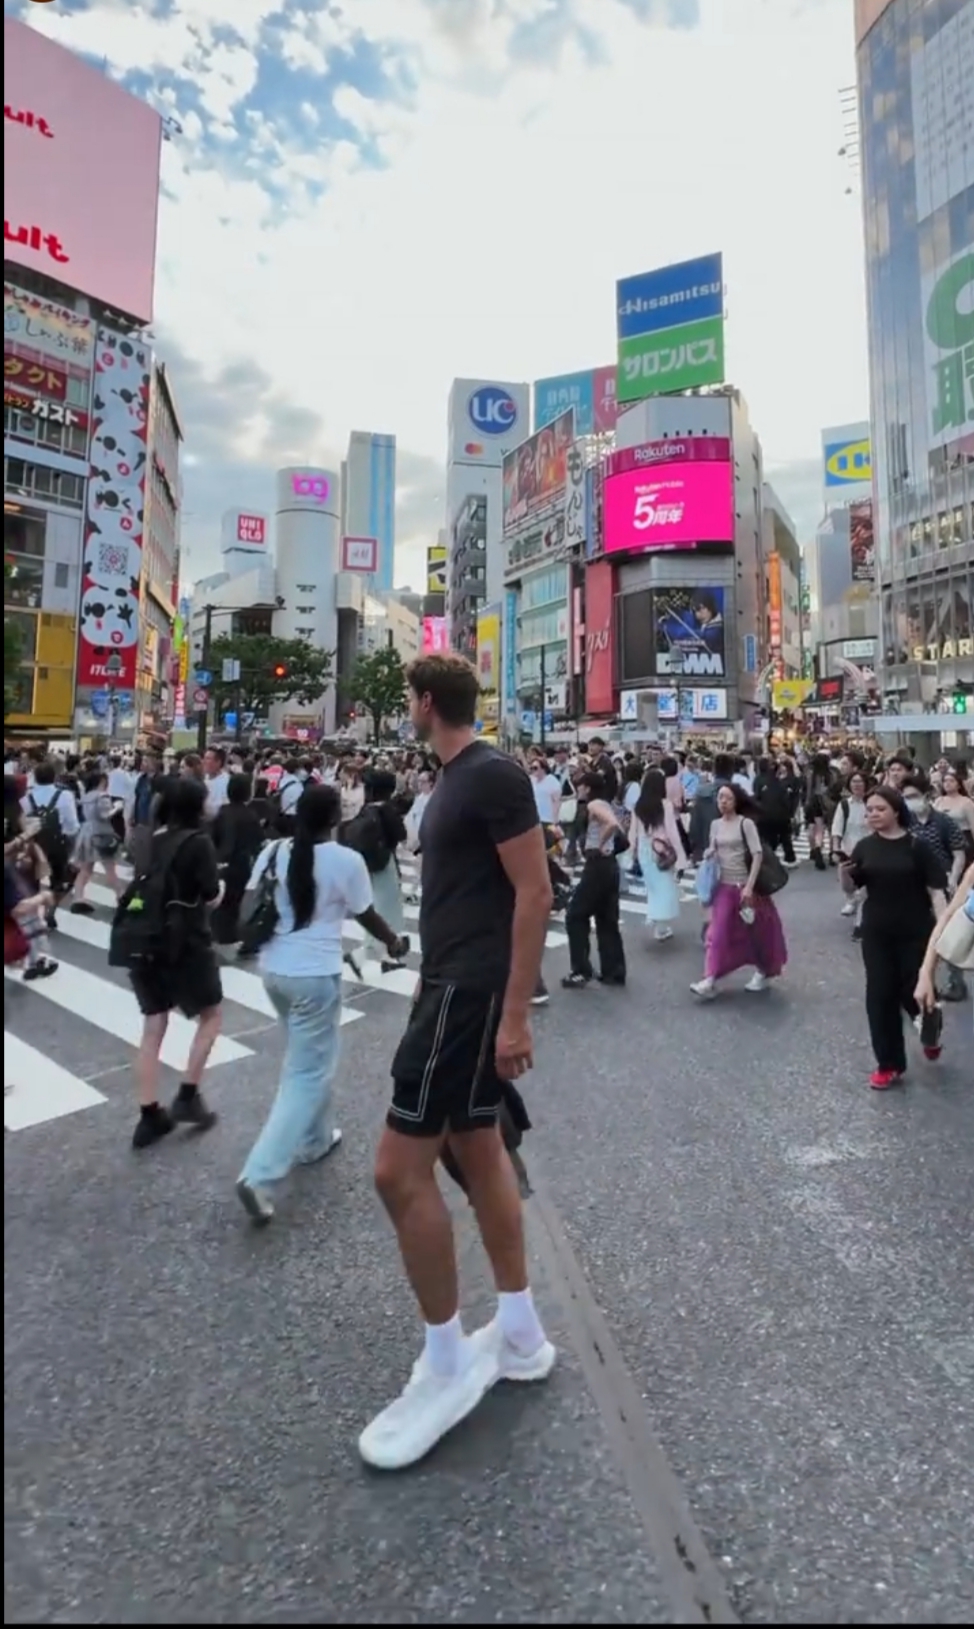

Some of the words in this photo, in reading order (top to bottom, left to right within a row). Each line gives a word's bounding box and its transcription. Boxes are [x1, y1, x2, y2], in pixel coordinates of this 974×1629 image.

[618, 281, 721, 316] Hisamitsu
[623, 338, 718, 381] サロンパス
[32, 399, 79, 426] ガスト
[471, 396, 516, 424] UC
[634, 443, 685, 461] Rakuten
[240, 517, 261, 529] UNI
[240, 529, 262, 542] QLO
[913, 638, 972, 661] STAR
[90, 664, 127, 678] 17LE
